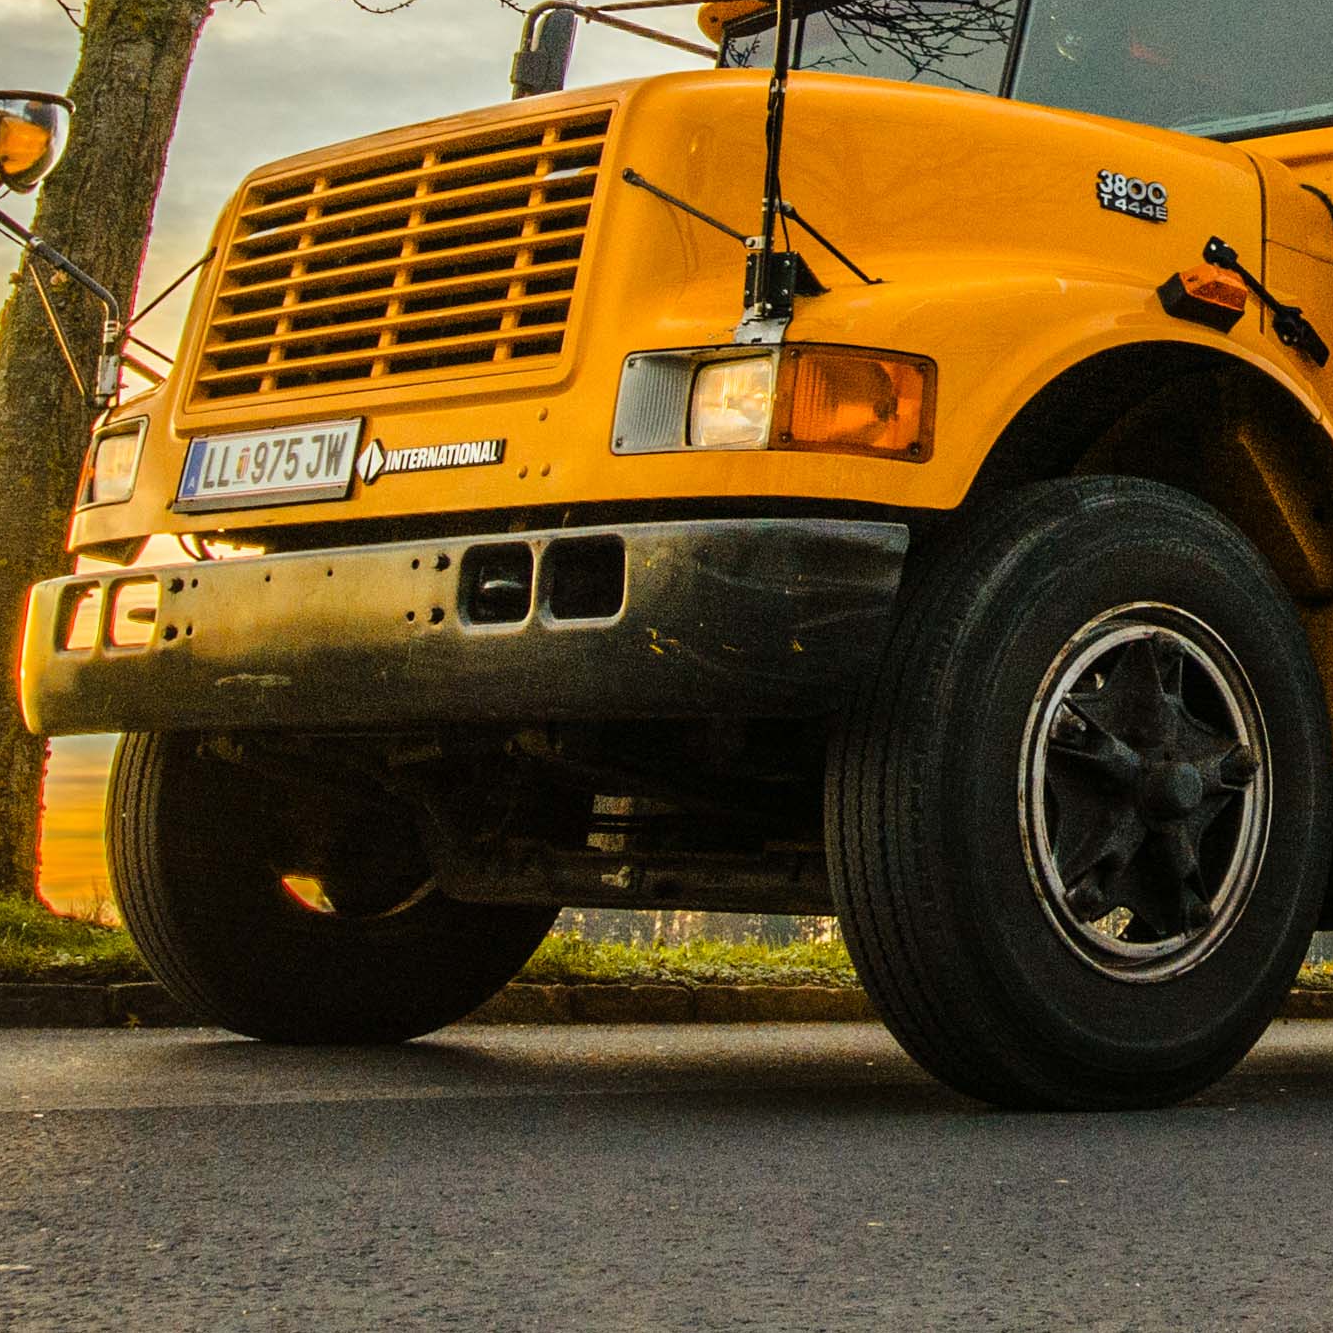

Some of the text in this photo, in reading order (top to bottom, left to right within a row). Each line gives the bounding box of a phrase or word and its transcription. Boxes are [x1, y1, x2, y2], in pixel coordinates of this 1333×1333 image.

[1099, 170, 1166, 204] 3800
[203, 446, 230, 489] LL
[251, 438, 303, 484] 975
[385, 440, 498, 471] INTERNATIONAL
